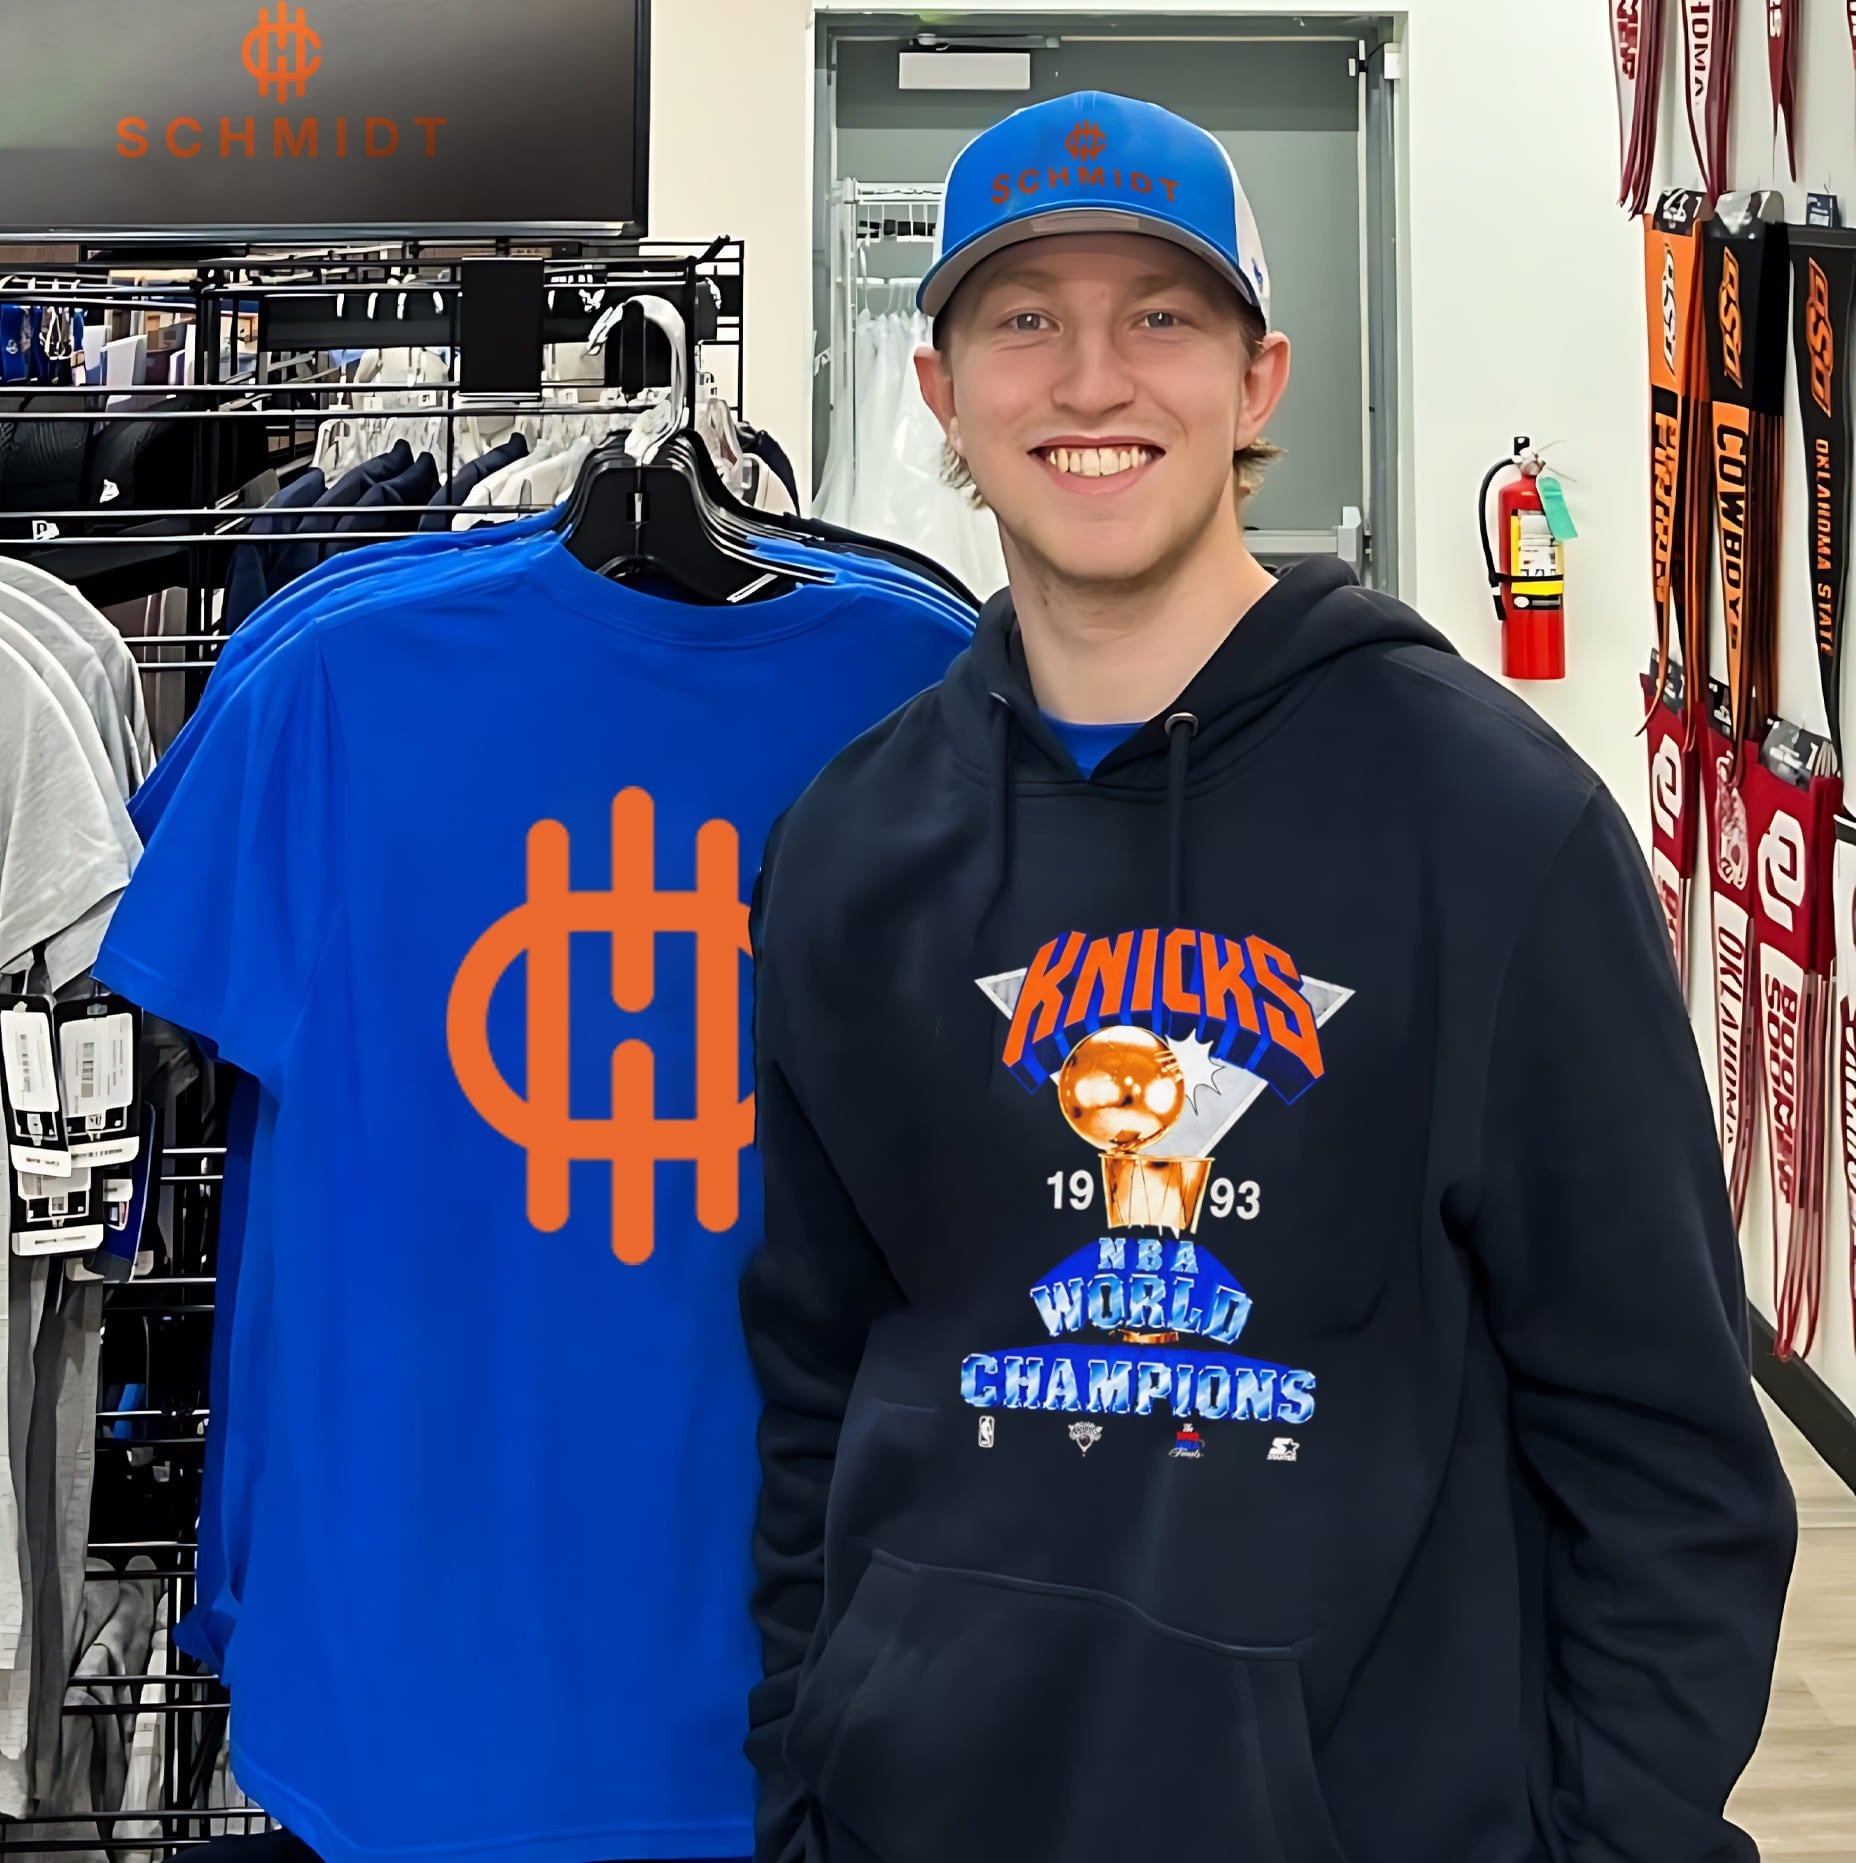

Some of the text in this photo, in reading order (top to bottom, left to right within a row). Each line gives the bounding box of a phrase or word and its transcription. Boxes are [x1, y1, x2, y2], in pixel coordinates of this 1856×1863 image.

[115, 116, 447, 159] SCHMIDT
[991, 167, 1179, 205] SCHMIDT
[1815, 438, 1832, 570] OKLAHOMA
[1003, 928, 1324, 1088] KNICKS
[1719, 926, 1746, 1144] OKLAHOMA
[1046, 1170, 1261, 1220] 19 93
[1098, 1237, 1199, 1275] NBA
[1030, 1273, 1253, 1345] WORLD
[960, 1353, 1317, 1424] CHAMPIONS
